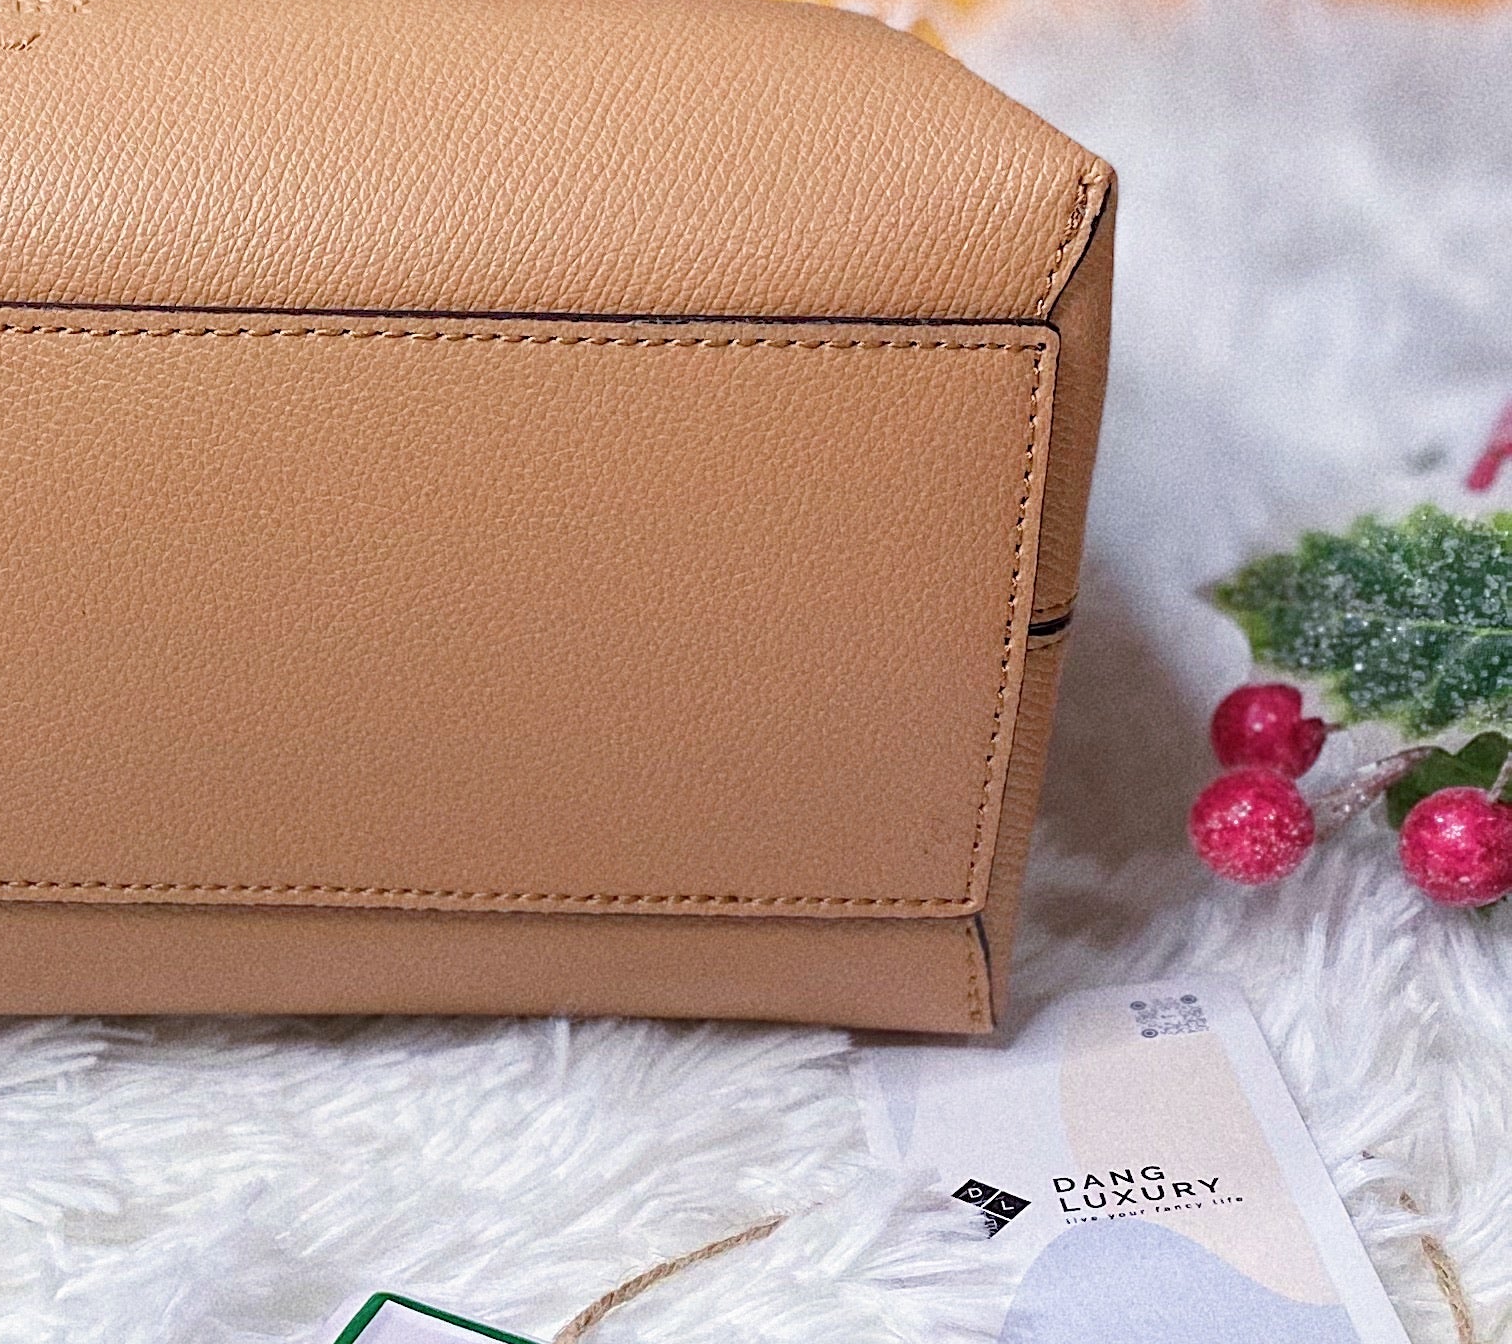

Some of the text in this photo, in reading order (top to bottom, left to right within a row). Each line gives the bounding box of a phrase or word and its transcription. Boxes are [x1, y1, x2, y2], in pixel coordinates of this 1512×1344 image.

[1052, 1165, 1165, 1193] DANG
[1059, 1177, 1219, 1213] LUXURY
[1065, 1196, 1244, 1225] live your fancy life
